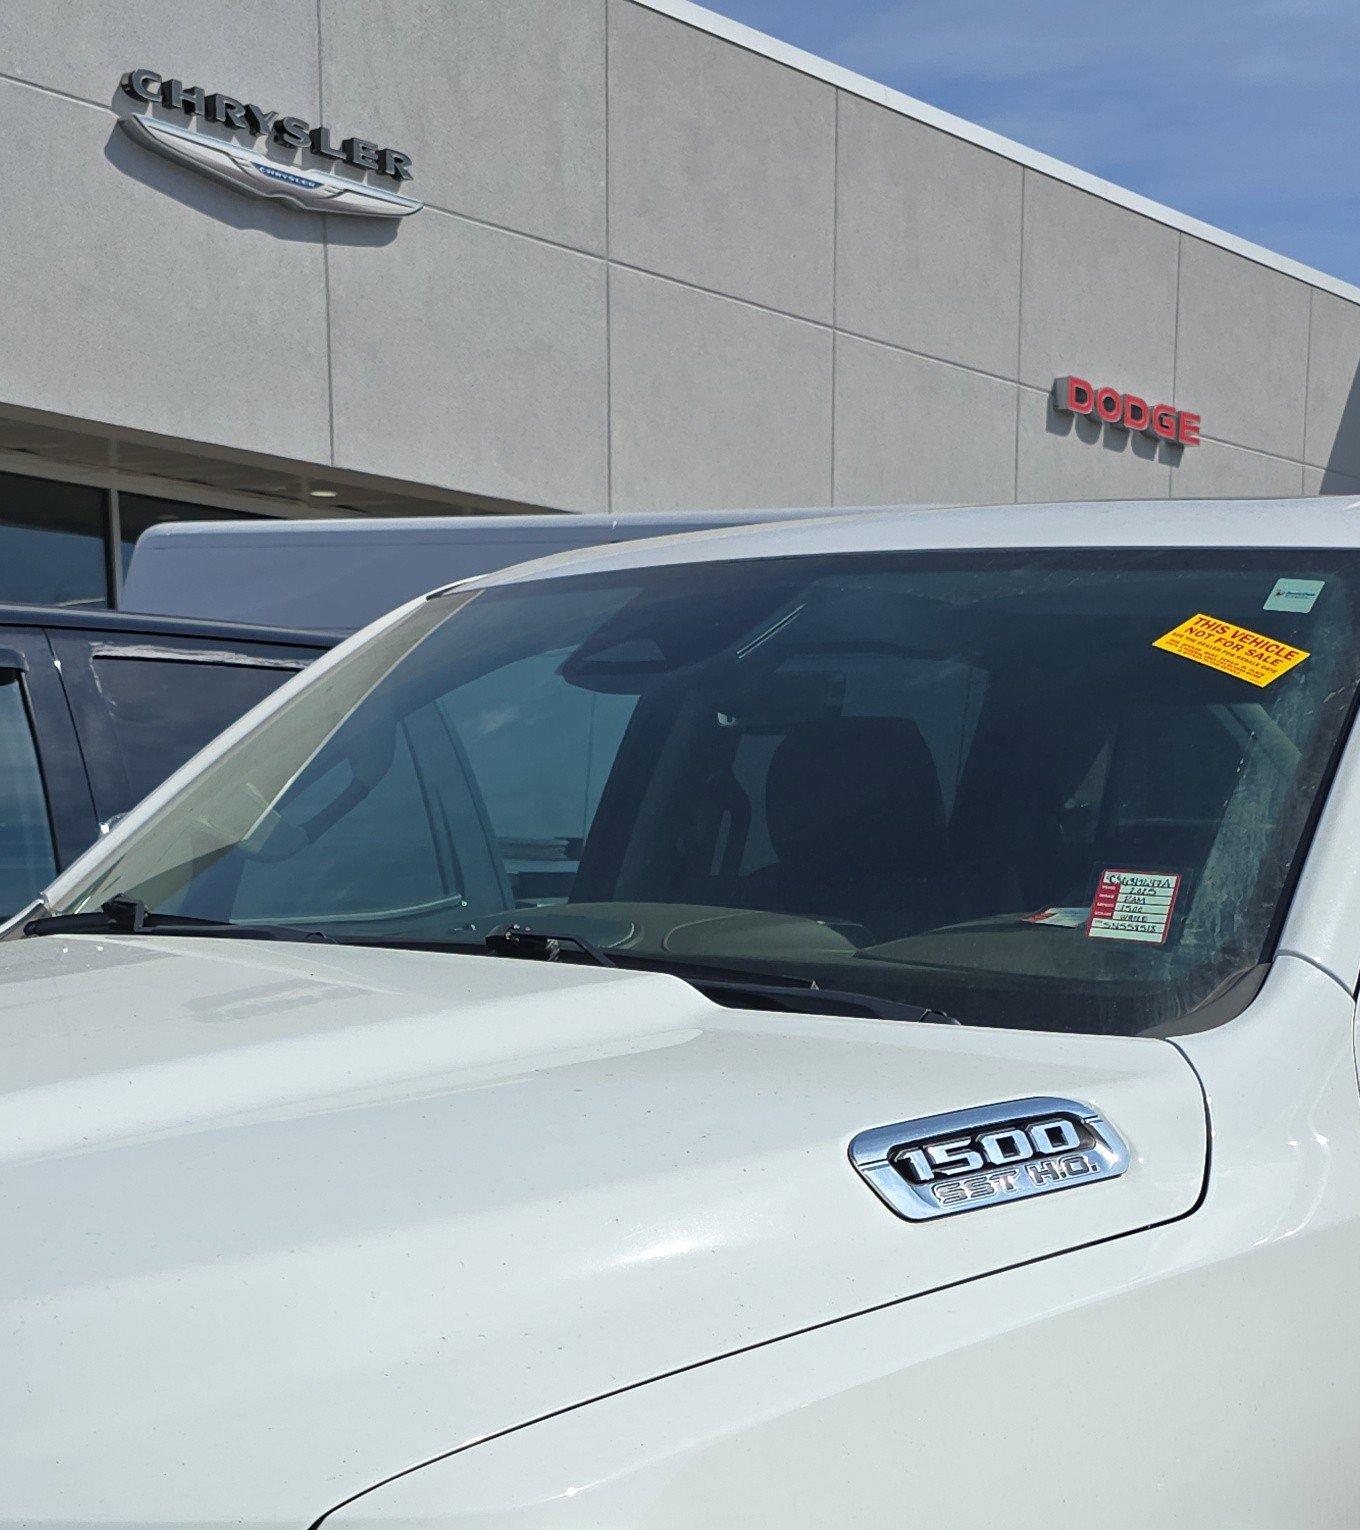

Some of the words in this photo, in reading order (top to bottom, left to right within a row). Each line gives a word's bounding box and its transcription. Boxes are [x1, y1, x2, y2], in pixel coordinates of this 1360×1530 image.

[123, 68, 414, 182] CHRYSLER
[1060, 375, 1201, 446] DODGE
[1185, 627, 1215, 640] NOT
[1214, 637, 1245, 652] FOR
[1244, 647, 1284, 666] SALE
[1193, 617, 1230, 634] THIS
[1230, 630, 1300, 661] VEHICLE
[1128, 887, 1157, 896] 2025
[896, 1120, 1081, 1181] 1500
[930, 1168, 1019, 1208] SST
